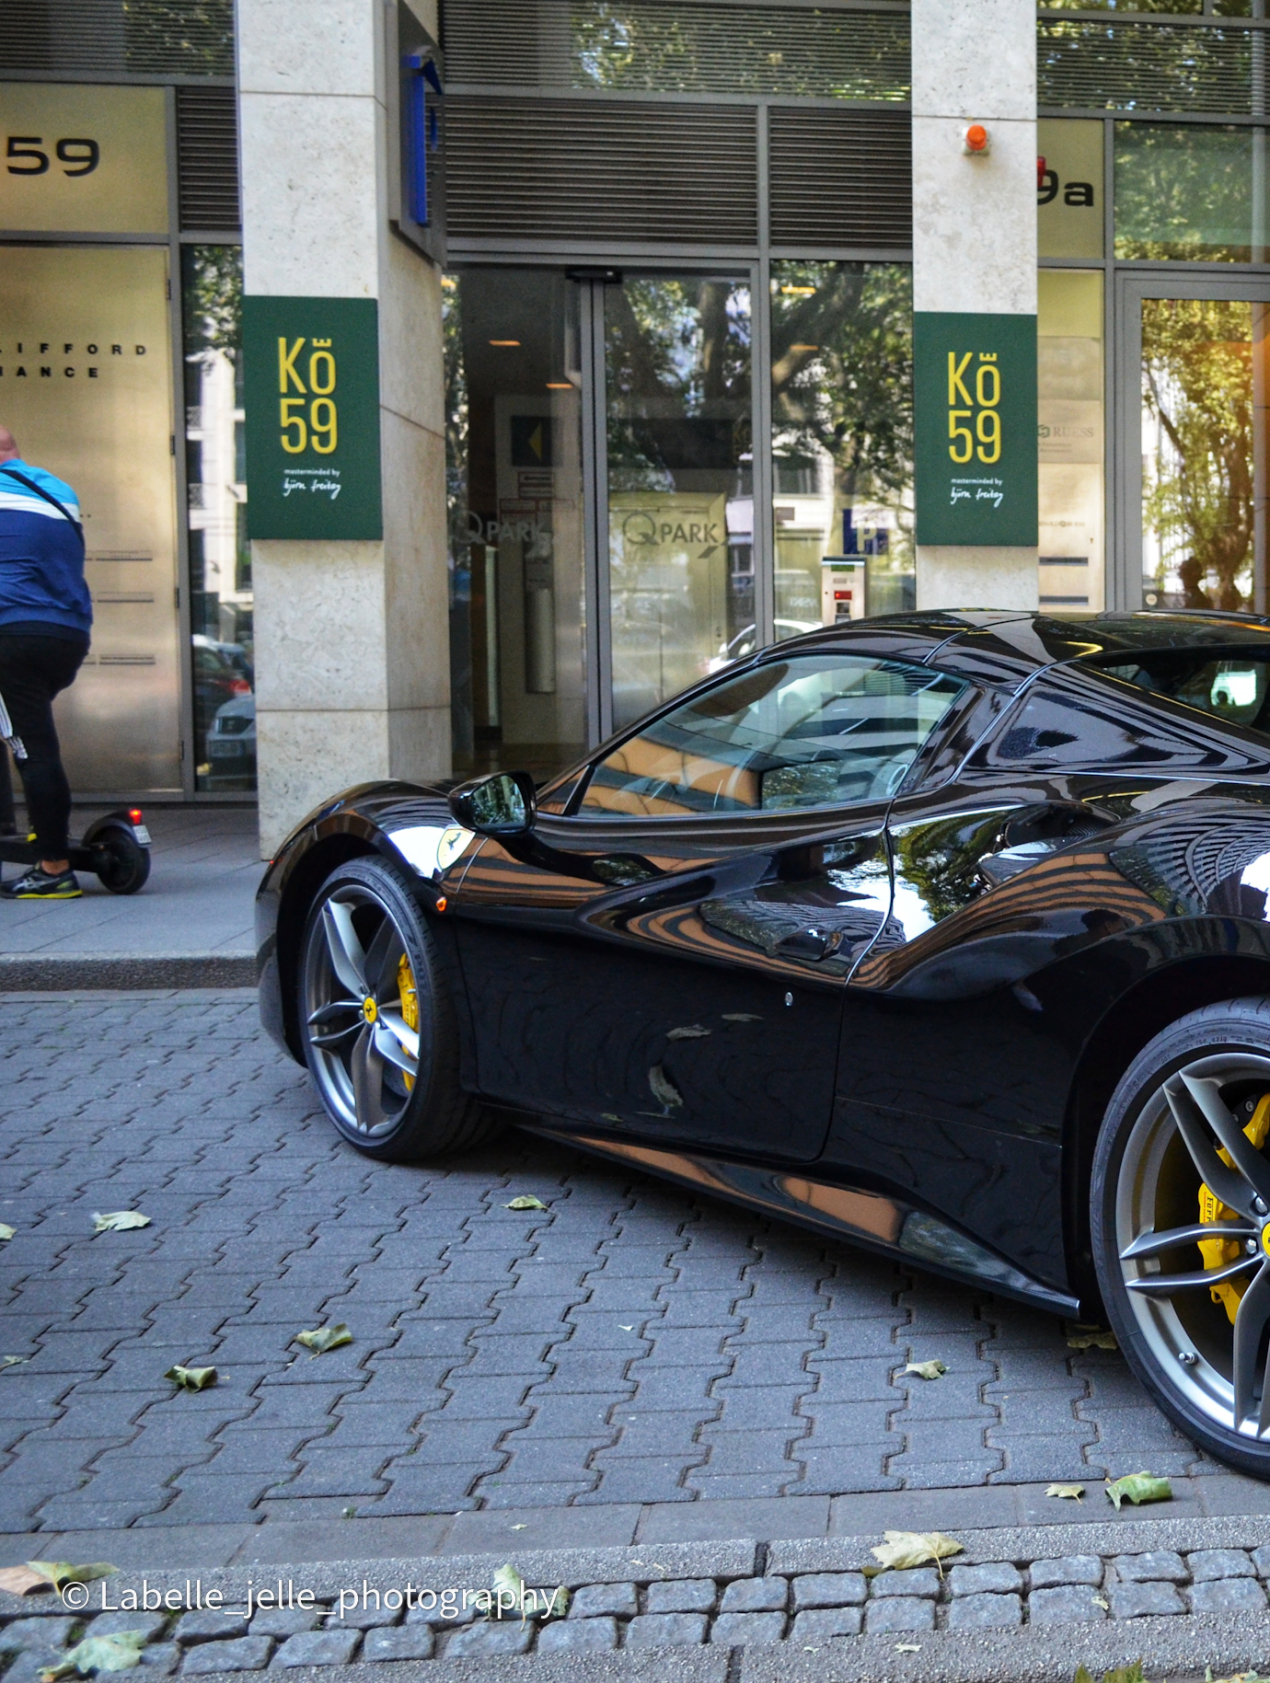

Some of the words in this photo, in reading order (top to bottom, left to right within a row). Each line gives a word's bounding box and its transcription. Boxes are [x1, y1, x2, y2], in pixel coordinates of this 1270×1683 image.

[7, 136, 100, 178] 59
[0, 342, 147, 356] IFFORD
[278, 337, 337, 395] KÖ
[948, 352, 1001, 408] KÖ
[279, 397, 339, 454] 59
[948, 409, 1002, 464] 59
[284, 468, 331, 476] masterminded
[331, 467, 341, 477] by
[951, 477, 994, 485] masterminded
[994, 476, 1004, 486] by
